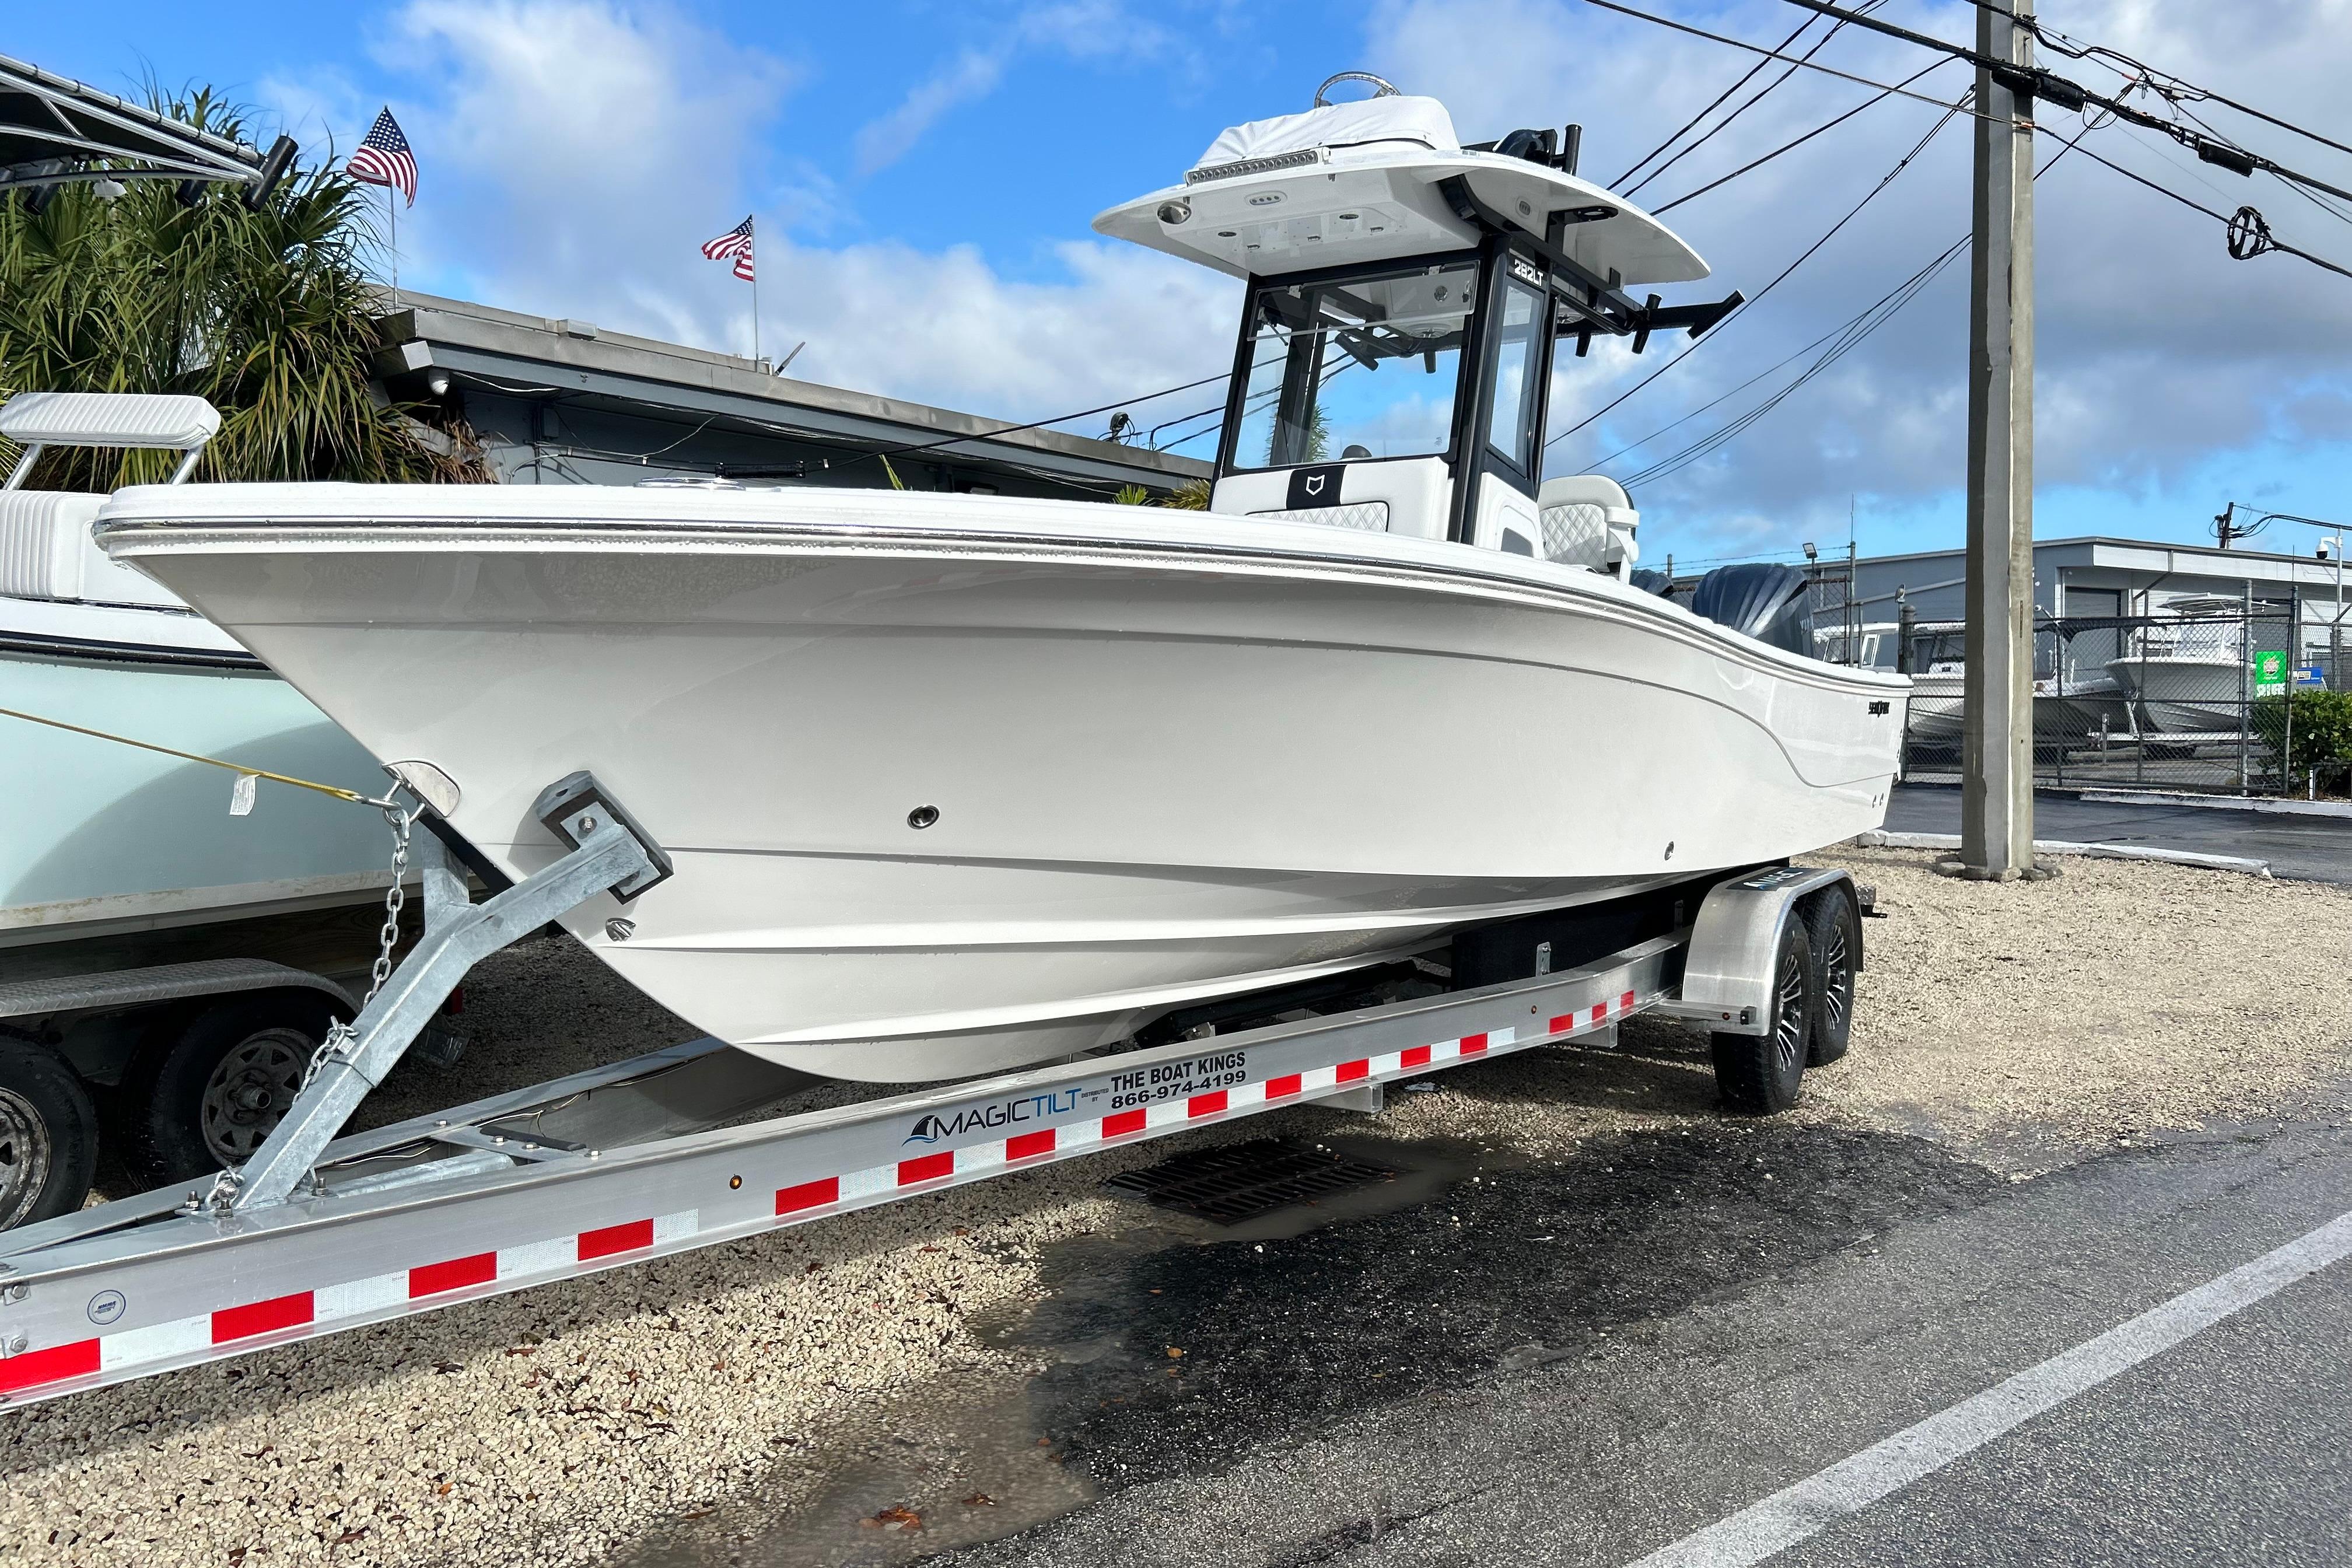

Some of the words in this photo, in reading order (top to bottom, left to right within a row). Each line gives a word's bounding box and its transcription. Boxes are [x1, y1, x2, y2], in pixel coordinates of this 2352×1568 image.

[1515, 259, 1544, 286] 282LT
[1111, 1071, 1144, 1093] THE
[1150, 1062, 1193, 1084] BOAT
[1198, 1052, 1245, 1075] KINGS
[1082, 1088, 1109, 1098] DISTRIBUTED
[1111, 1070, 1246, 1109] 866-974-4199
